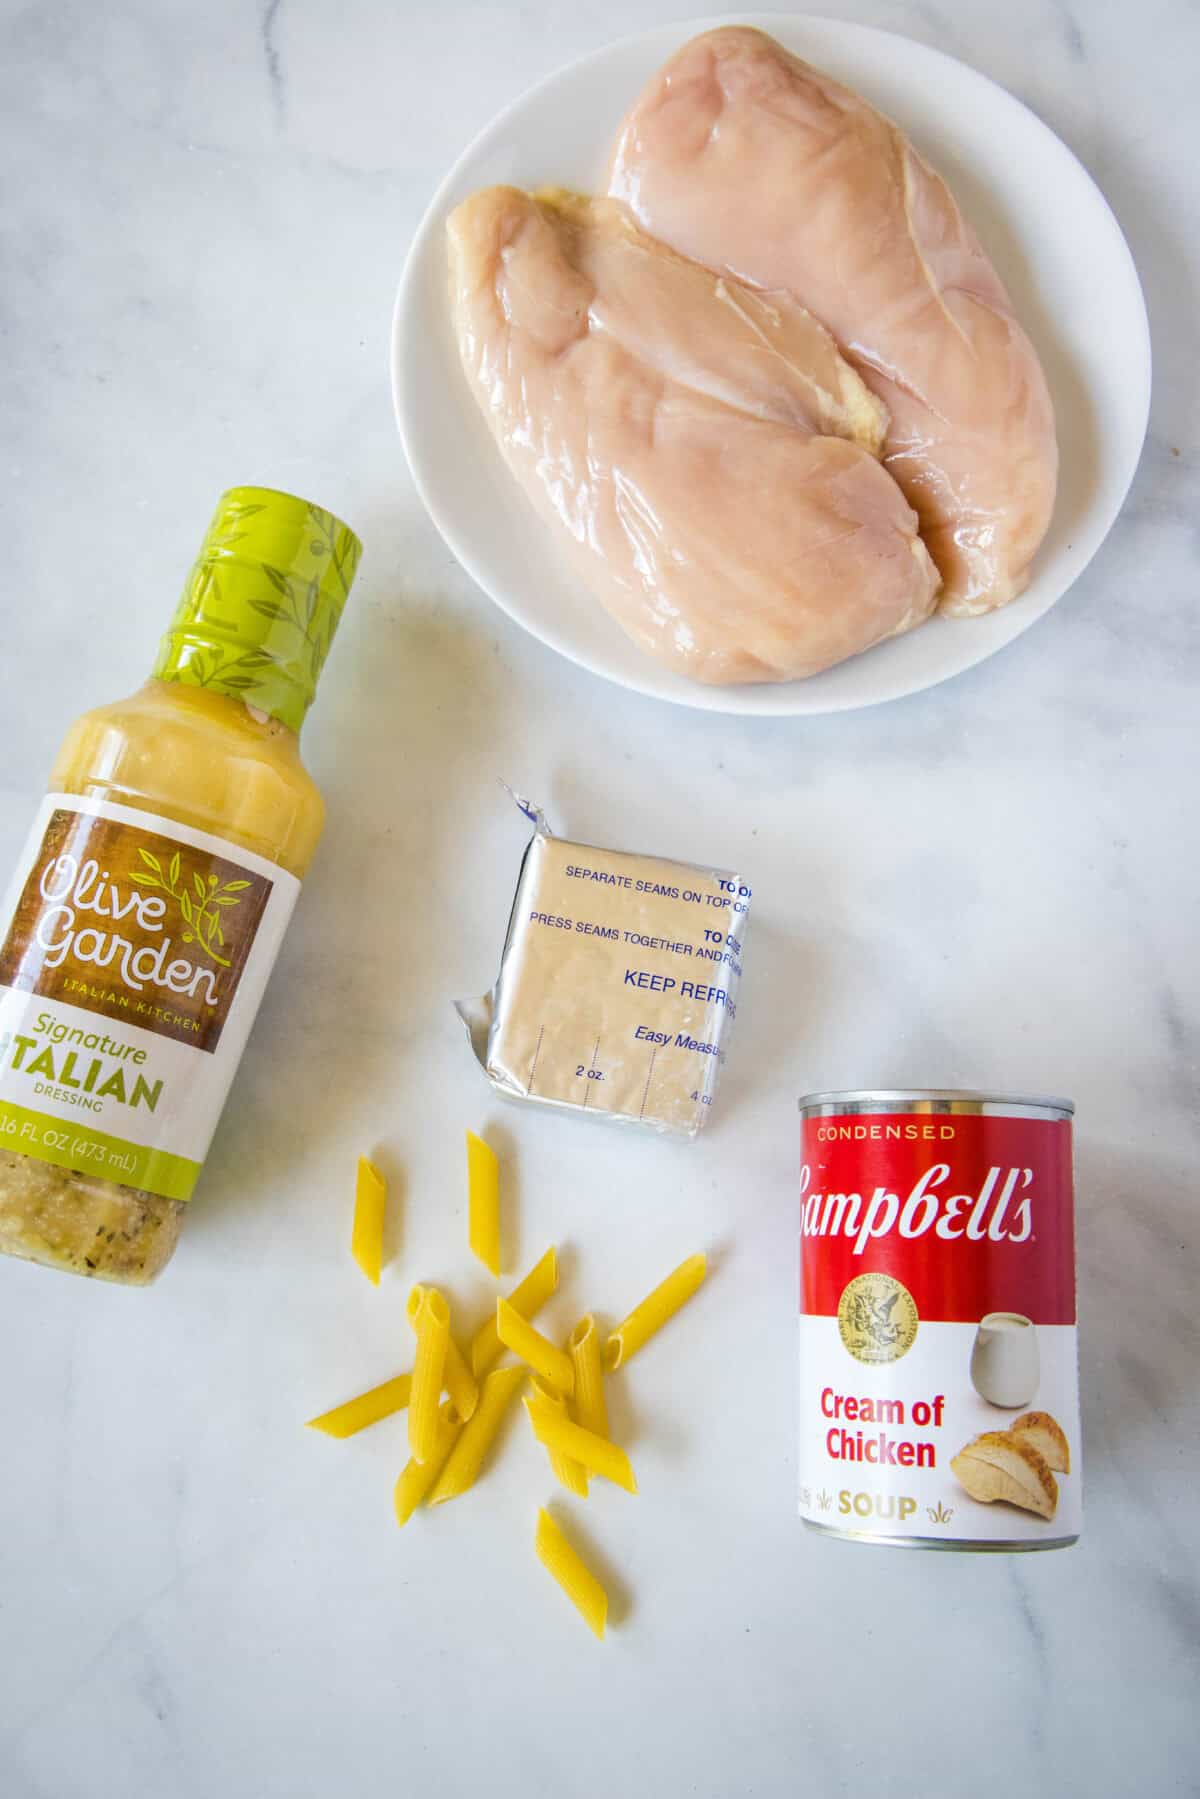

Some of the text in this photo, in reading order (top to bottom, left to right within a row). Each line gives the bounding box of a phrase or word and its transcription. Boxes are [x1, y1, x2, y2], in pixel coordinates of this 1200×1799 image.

[39, 853, 167, 932] Olive
[565, 866, 632, 889] SEPARATE
[635, 880, 679, 899] SEAMS
[682, 890, 703, 904] ON
[706, 894, 731, 909] TOP
[718, 879, 736, 893] TO
[36, 904, 219, 1006] Garden
[529, 911, 572, 930] PRESS
[575, 919, 620, 940] SEAMS
[623, 931, 693, 956] TOGETHER
[695, 948, 723, 963] AND
[703, 929, 722, 944] TO
[624, 969, 676, 994] KEEP
[63, 977, 202, 1033] ITALIAN KITCHEN
[32, 1013, 148, 1065] Signature
[635, 1025, 673, 1047] Easy
[4, 1034, 165, 1114] TALIAN
[575, 1064, 586, 1077] 2
[34, 1081, 105, 1114] DRESSING
[690, 1089, 699, 1102] 4
[0, 1114, 138, 1175] 16 FL OZ (473 mL)
[816, 1125, 956, 1142] CONDENSED
[820, 1386, 945, 1427] Cream of
[825, 1427, 937, 1469] Chicken
[837, 1489, 918, 1521] SOUP
